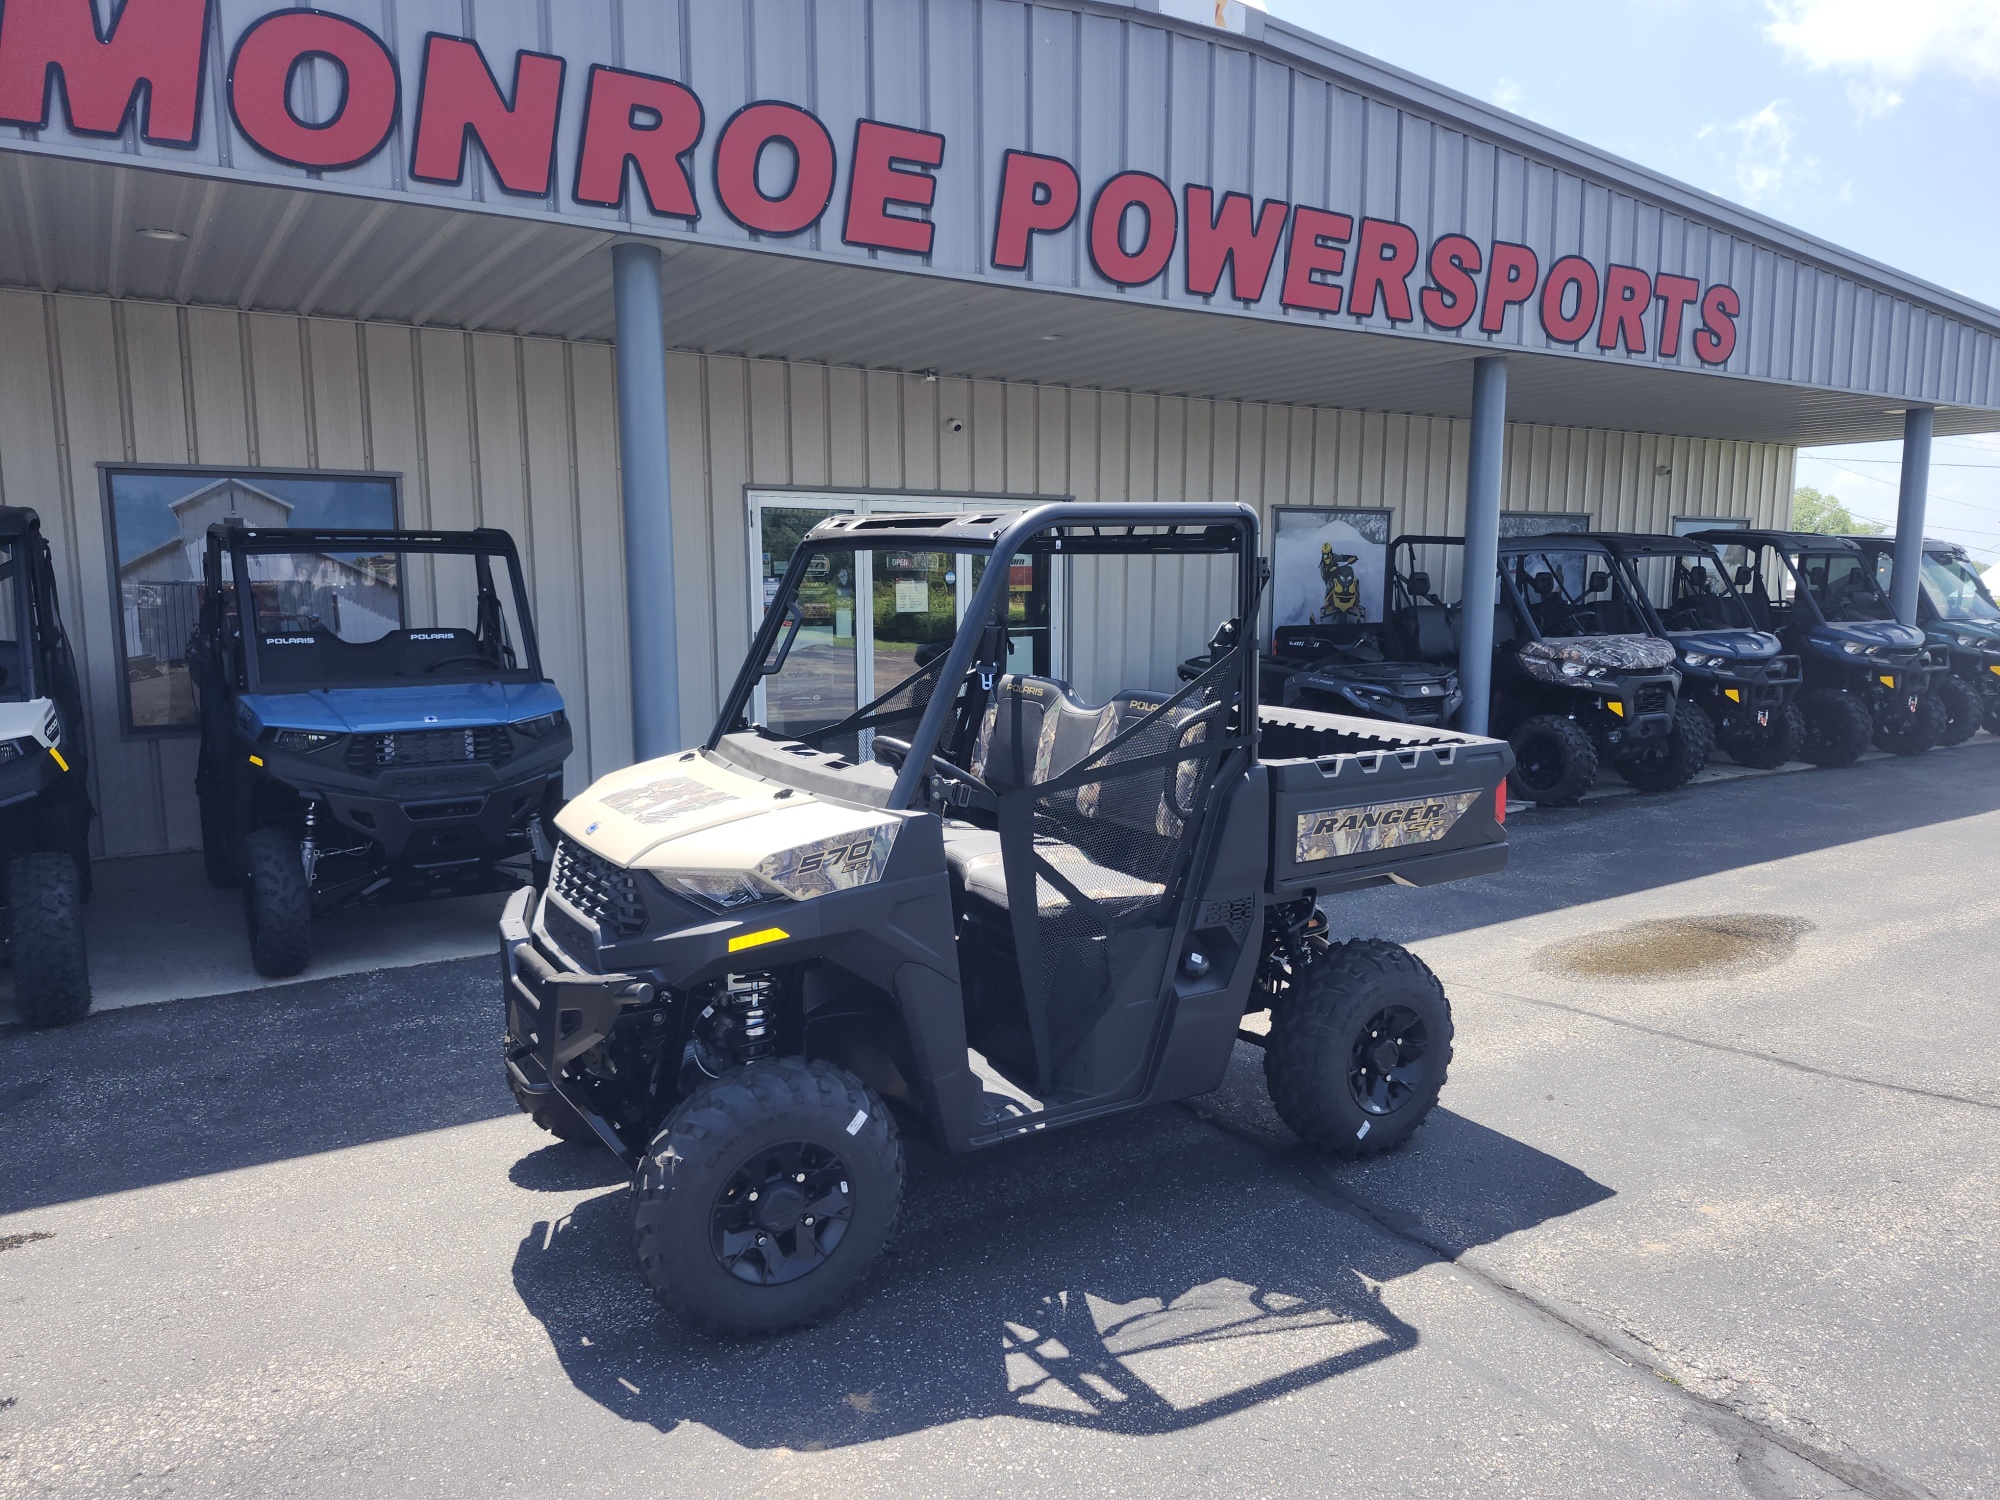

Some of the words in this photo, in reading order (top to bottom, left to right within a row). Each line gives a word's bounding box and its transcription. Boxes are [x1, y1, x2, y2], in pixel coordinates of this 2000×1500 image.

[0, 0, 946, 256] MONROE
[992, 148, 1740, 366] POWERSPORTS
[891, 558, 908, 566] OPEN
[266, 637, 315, 645] POLARIS
[410, 632, 455, 640] POLARIS
[1006, 683, 1044, 697] POLARIS
[392, 771, 482, 789] POLARIS
[1311, 803, 1446, 837] RANGER
[1407, 818, 1447, 833] SP
[795, 839, 874, 877] 570
[841, 859, 872, 874] EFI
